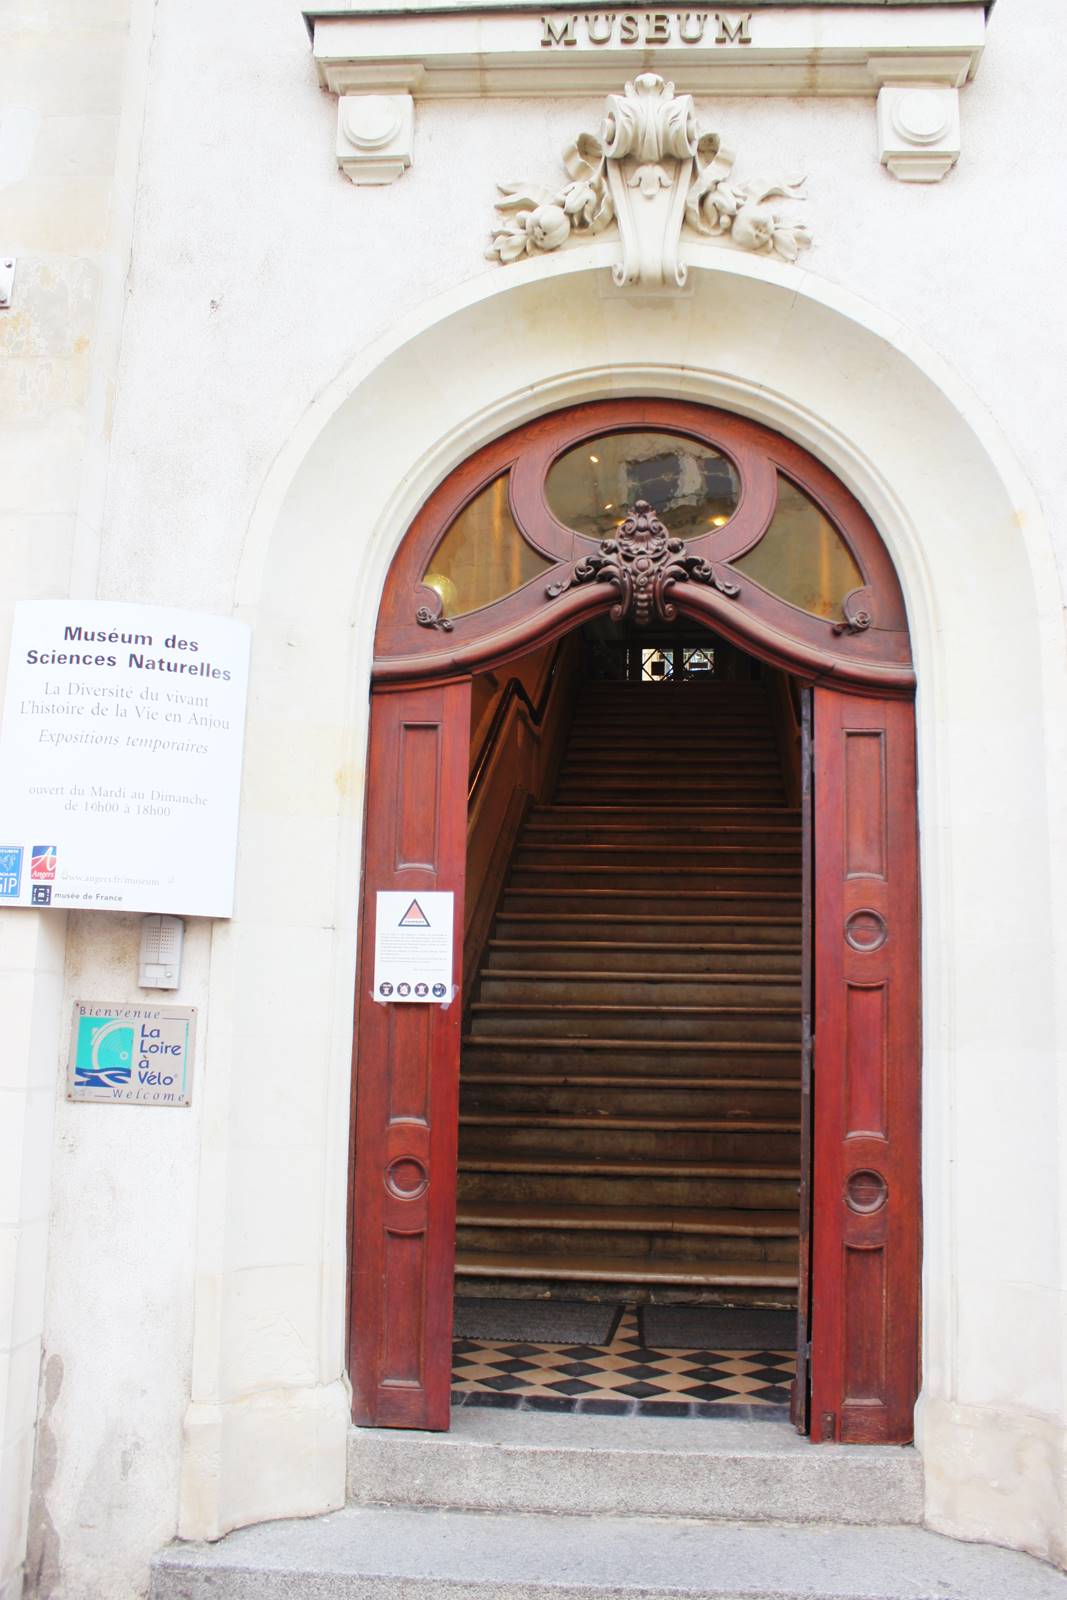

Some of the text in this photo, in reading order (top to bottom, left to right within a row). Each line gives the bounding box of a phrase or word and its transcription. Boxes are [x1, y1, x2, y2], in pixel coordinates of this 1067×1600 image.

[541, 13, 752, 46] MUSEUM
[64, 626, 199, 652] Muséum des
[26, 650, 232, 680] Sciences Naturelles
[45, 682, 209, 708] La Diversité du vivant
[20, 701, 230, 731] L'histoire de la Vie en Anjou
[38, 729, 209, 754] Expositions temporaires
[29, 784, 208, 807] ouvert du Mardi au Dimanche
[64, 800, 79, 811] de
[96, 893, 123, 901] France
[80, 1006, 161, 1019] Bienvenue
[141, 1024, 160, 1038] La
[140, 1040, 182, 1056] Loire
[139, 1056, 149, 1068] à
[138, 1072, 174, 1085] Vélo
[112, 1088, 185, 1102] Welcome
